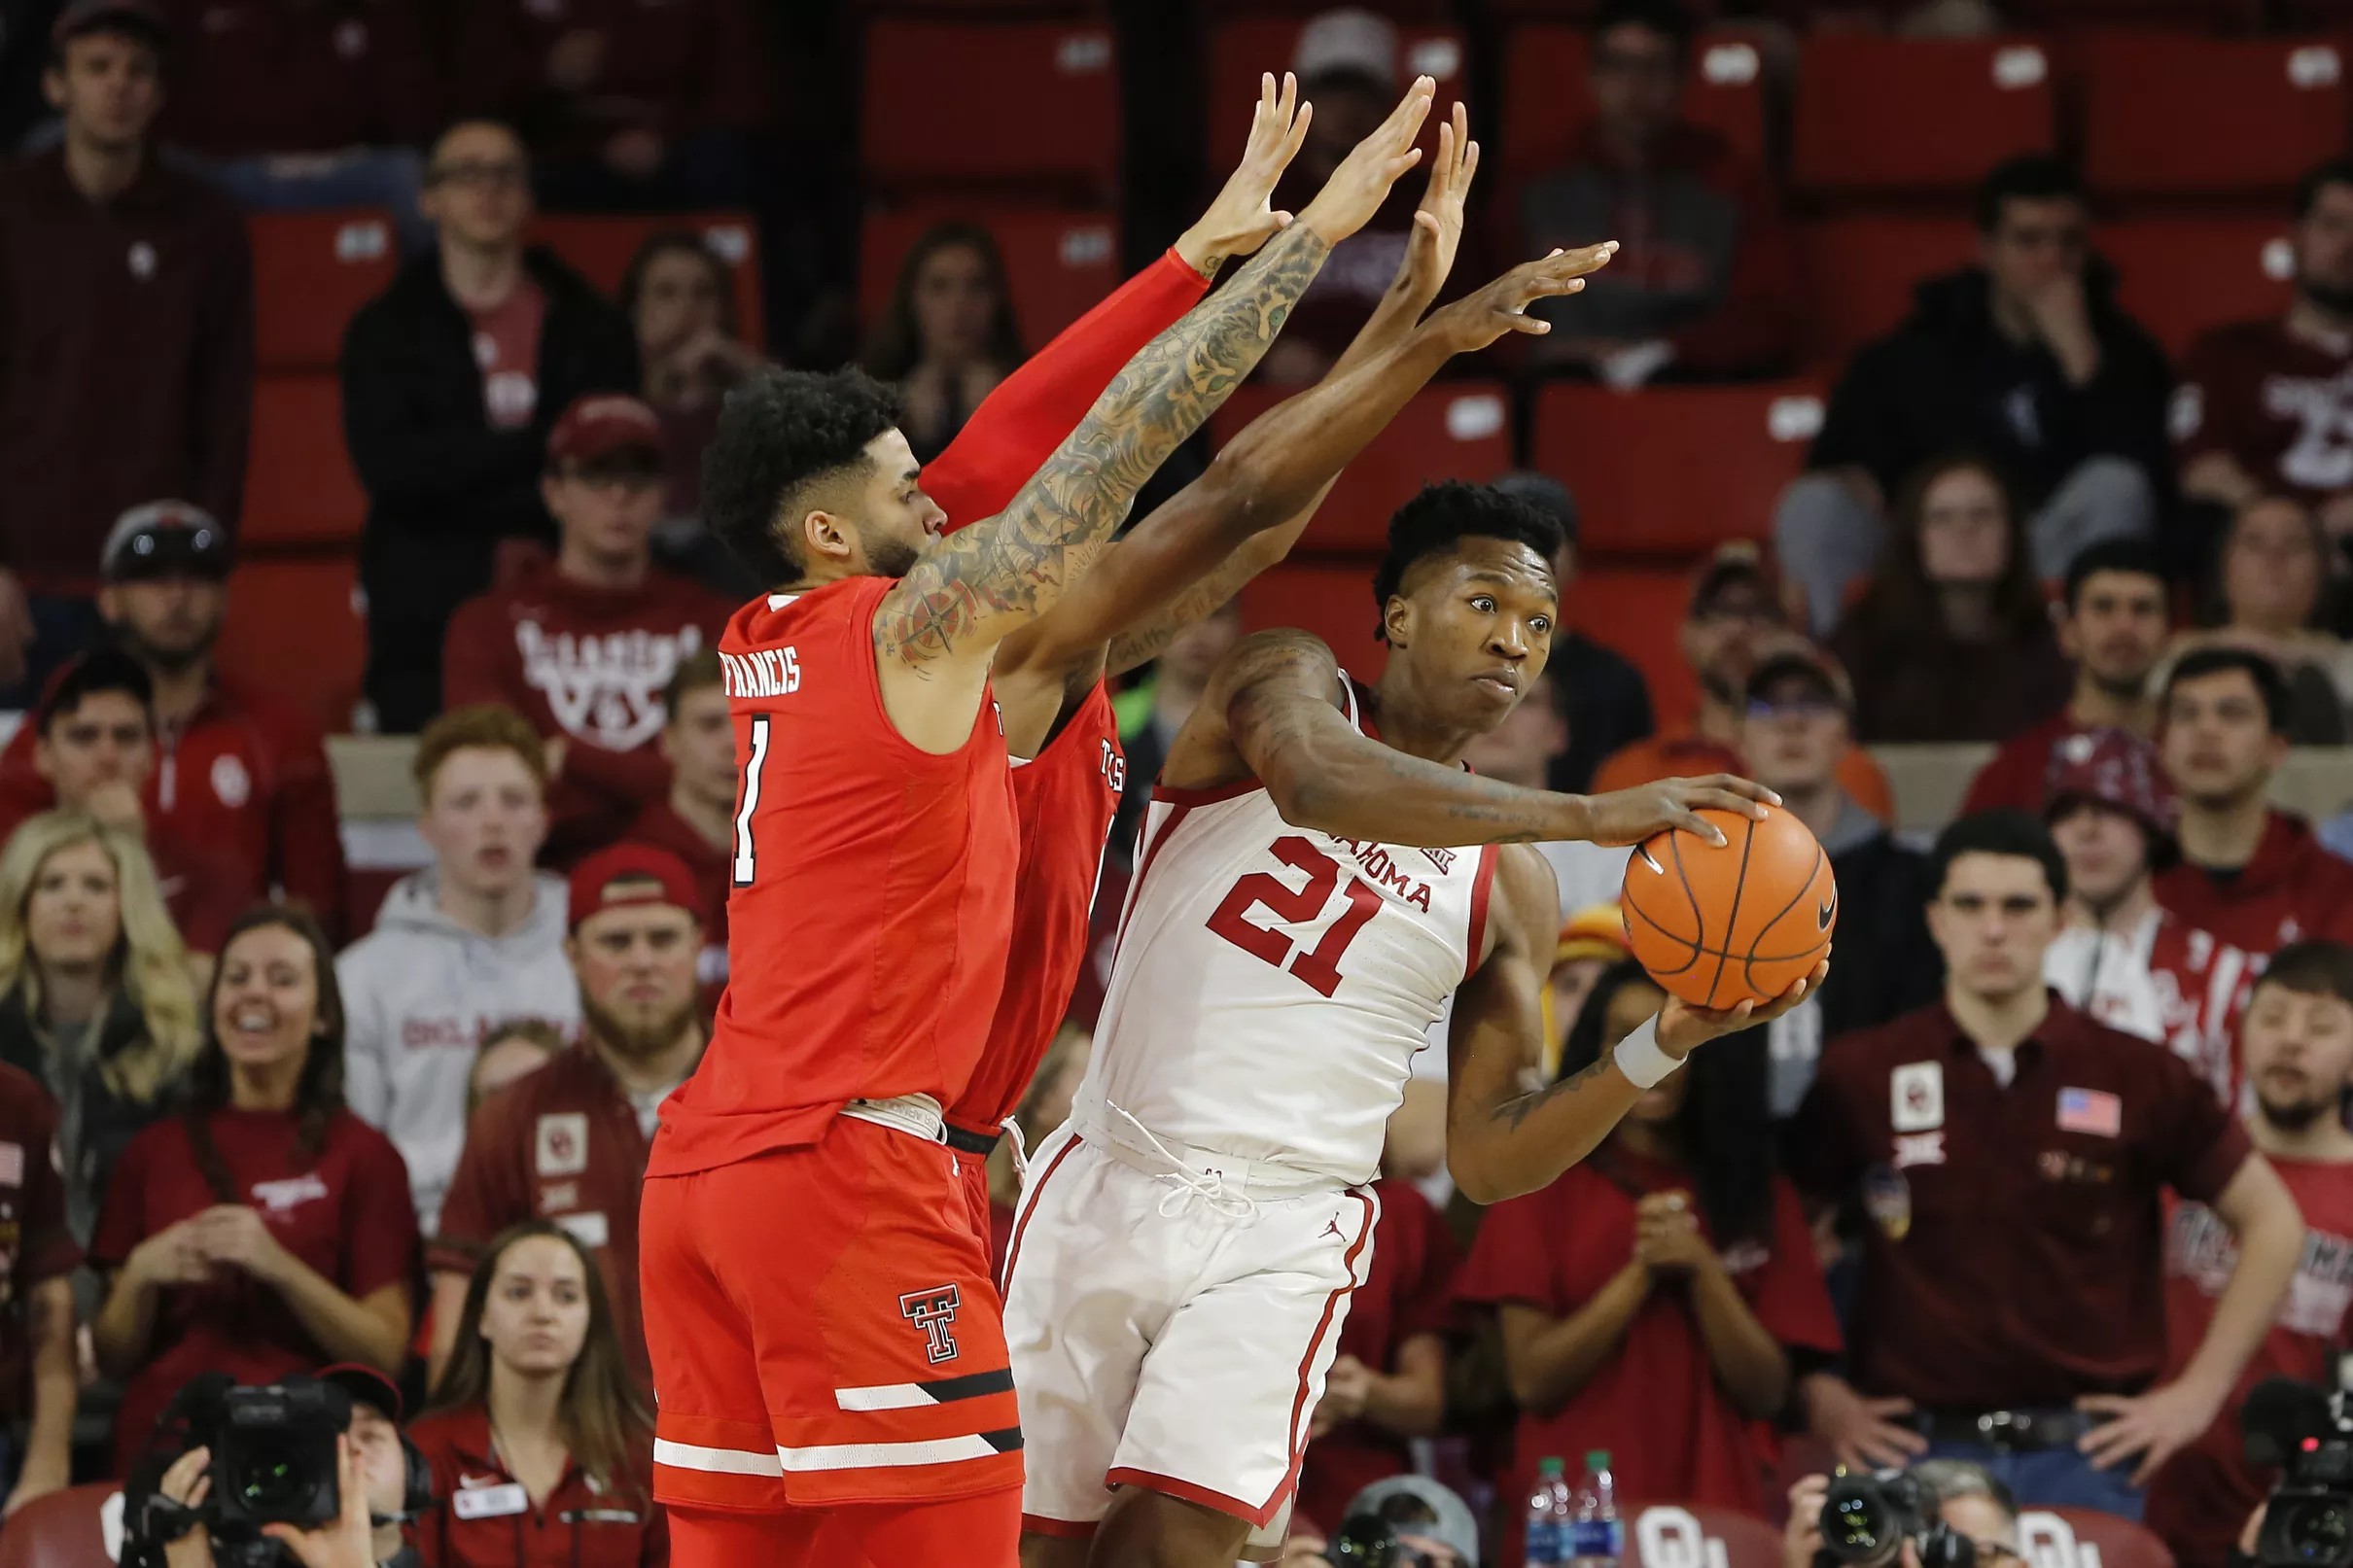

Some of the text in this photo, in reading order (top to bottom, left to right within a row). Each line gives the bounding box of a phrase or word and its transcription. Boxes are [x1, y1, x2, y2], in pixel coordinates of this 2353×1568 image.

[718, 645, 801, 698] FRANCIS
[733, 714, 770, 889] 1
[1205, 836, 1385, 998] 21
